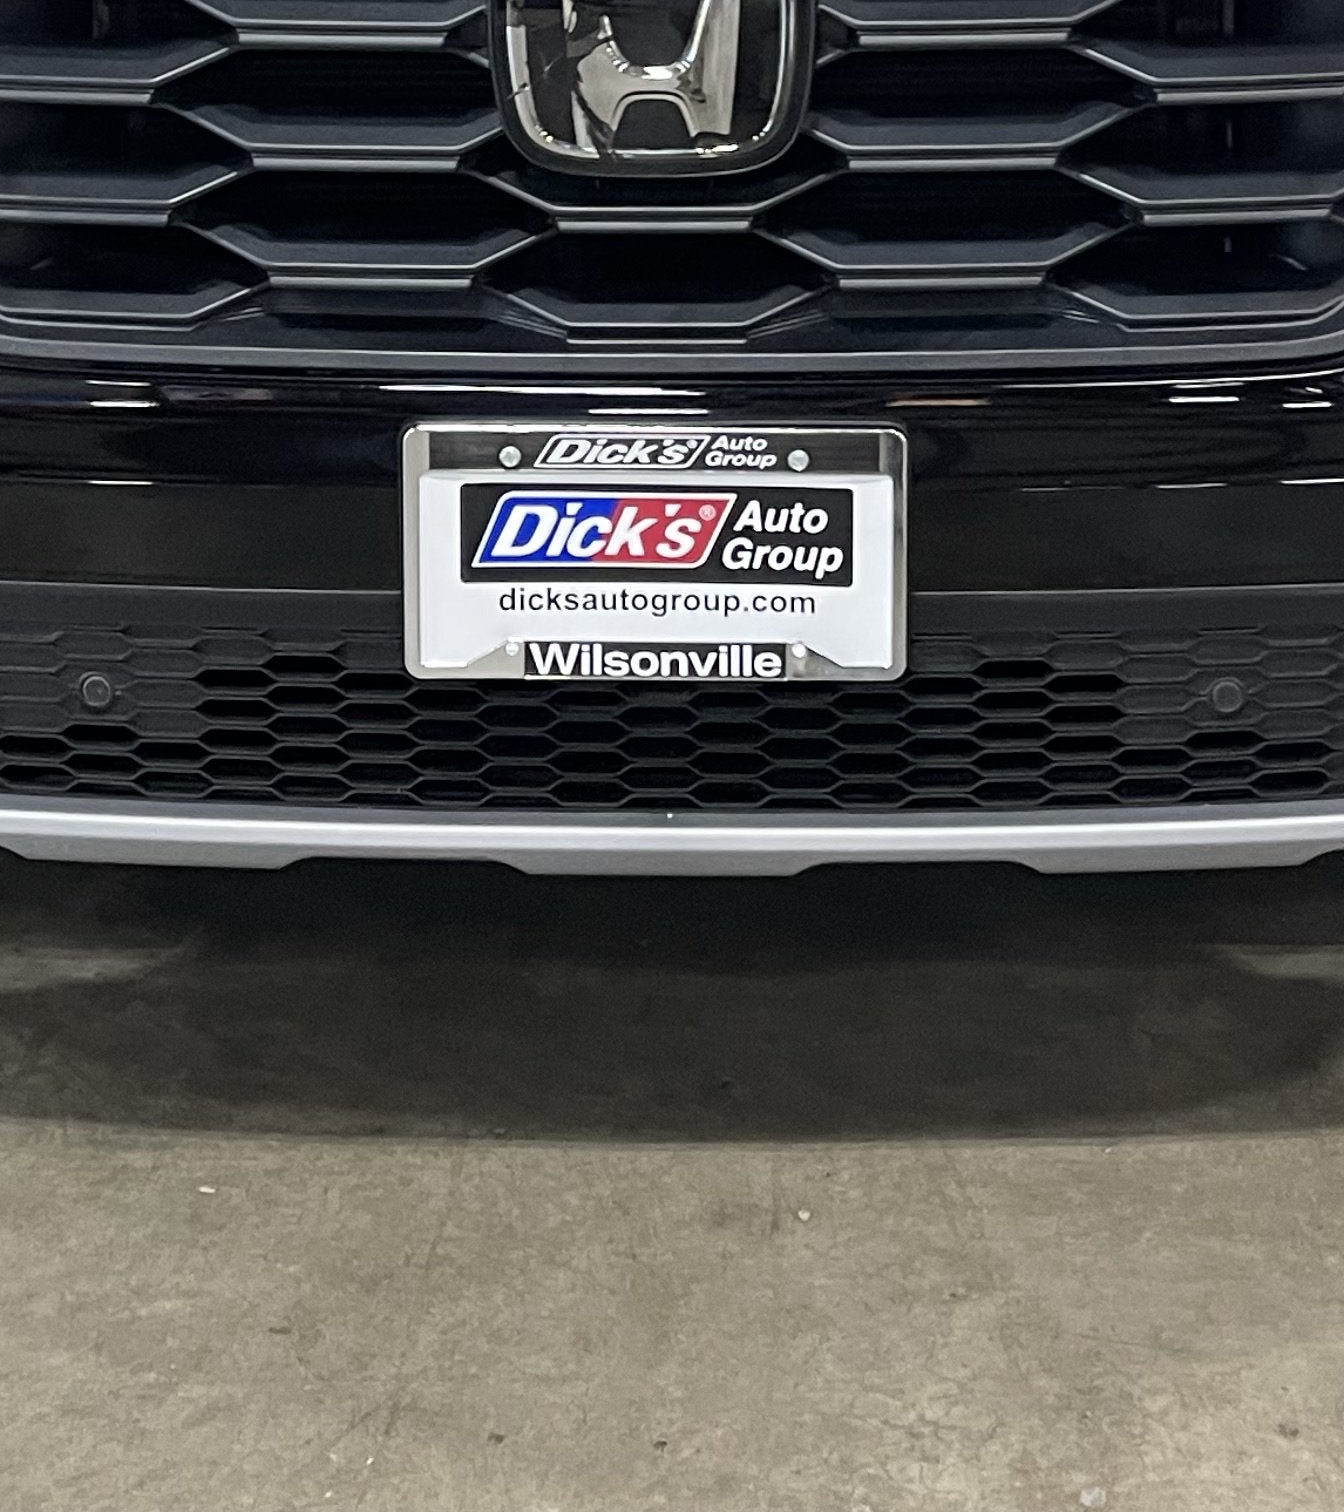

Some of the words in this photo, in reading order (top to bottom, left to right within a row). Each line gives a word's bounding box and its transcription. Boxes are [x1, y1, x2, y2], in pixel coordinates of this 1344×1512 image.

[710, 434, 768, 452] Auto
[704, 451, 778, 470] Group
[732, 499, 830, 535] Auto
[721, 537, 845, 580] Group
[498, 587, 816, 617] dicksautogroup.com
[527, 642, 783, 678] Wilsonville
